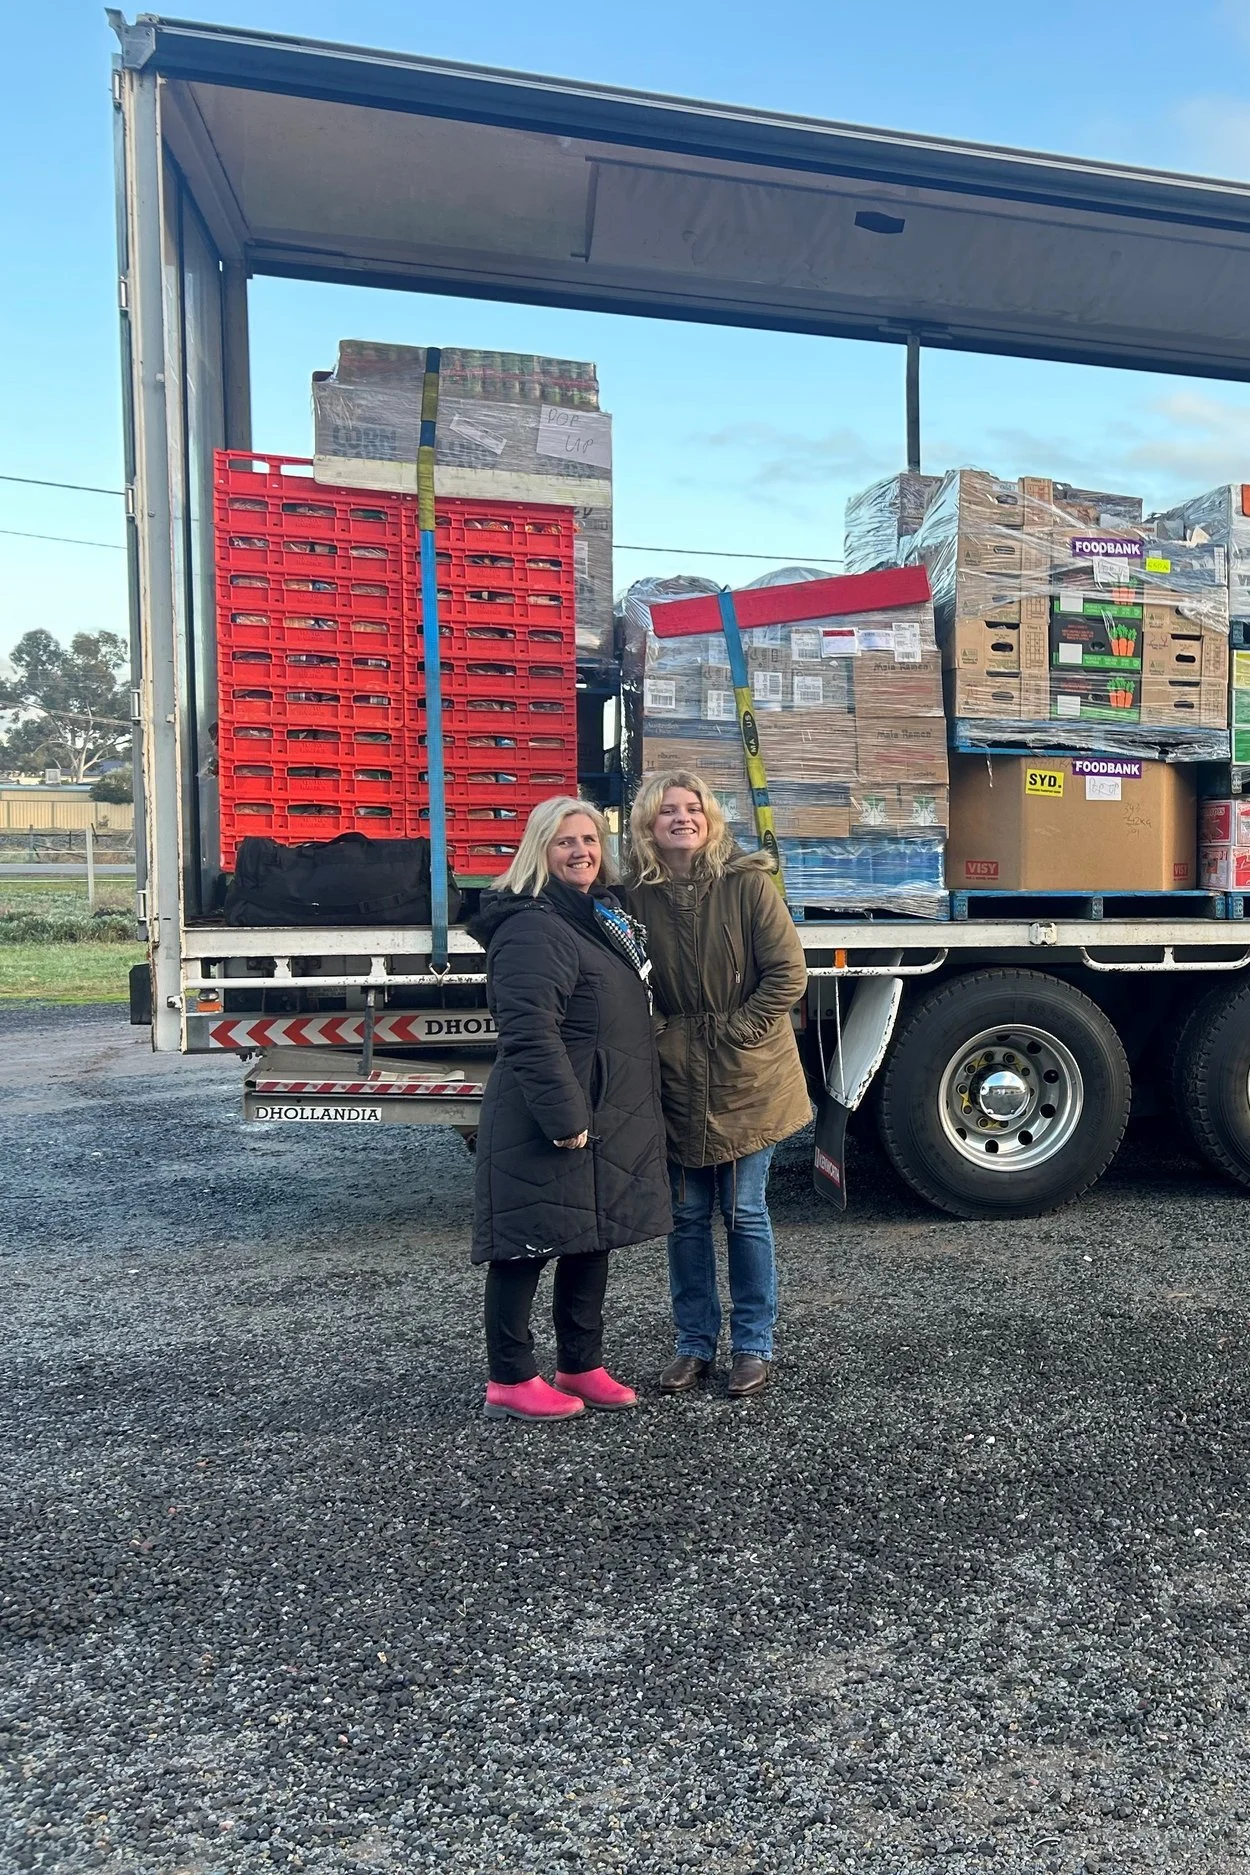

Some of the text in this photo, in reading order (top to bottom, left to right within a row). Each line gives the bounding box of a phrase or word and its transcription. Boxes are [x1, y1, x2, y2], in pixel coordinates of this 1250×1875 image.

[1076, 541, 1141, 555] FOODBANK
[1075, 760, 1140, 775] FOODBANK
[1029, 773, 1062, 789] SYD.
[967, 862, 997, 876] VISY
[425, 1018, 498, 1036] DHOL
[255, 1106, 380, 1122] DHOLLANDIA
